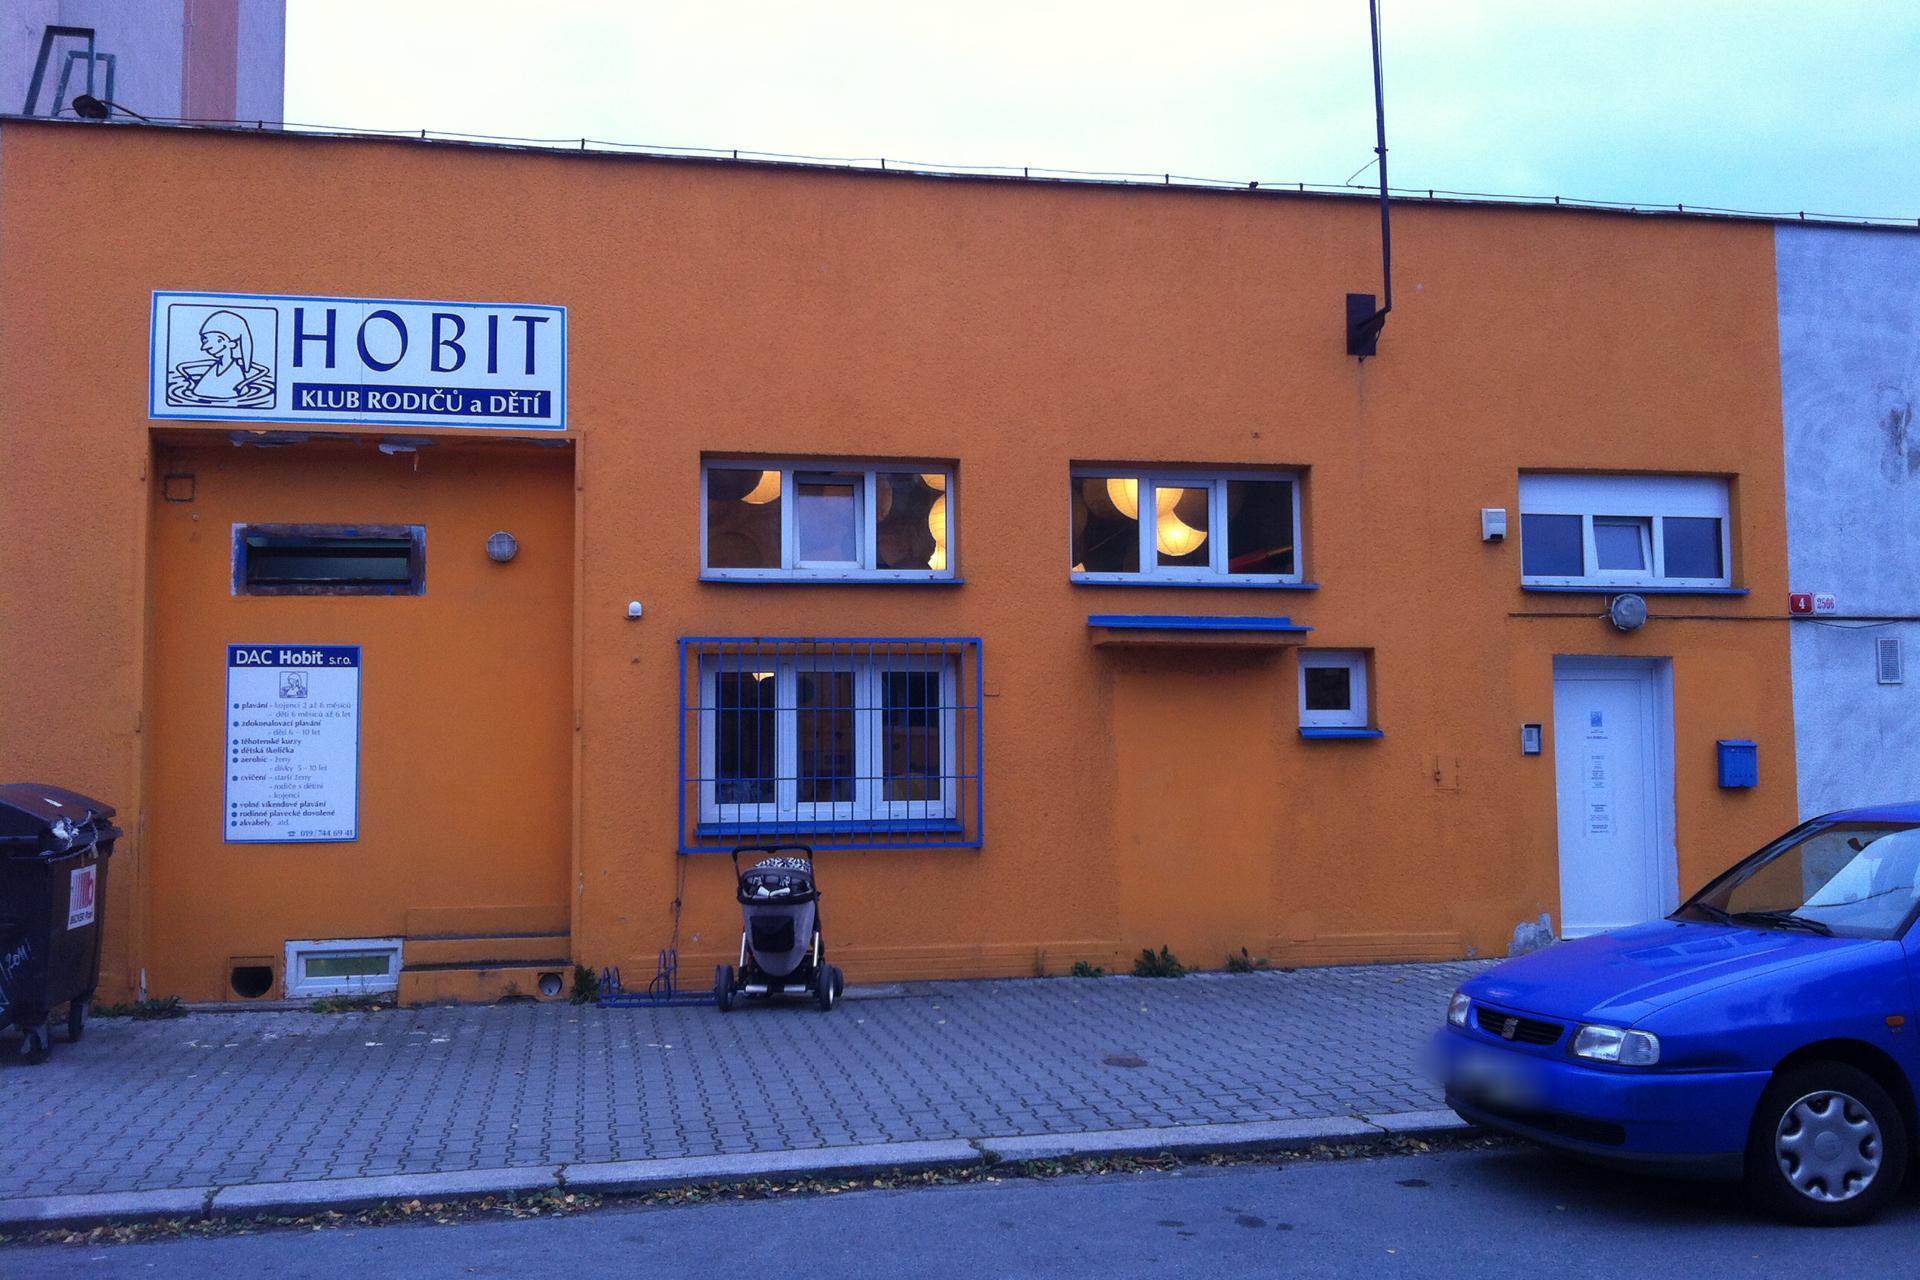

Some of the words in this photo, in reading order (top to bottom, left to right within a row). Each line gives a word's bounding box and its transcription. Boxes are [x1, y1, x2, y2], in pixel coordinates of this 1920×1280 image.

[293, 307, 550, 375] HOBIT
[301, 390, 360, 409] KLUB
[368, 389, 462, 412] RODIČŮ
[470, 400, 482, 413] a
[490, 391, 541, 415] DĚTÍ
[1799, 598, 1806, 609] 4
[236, 650, 272, 664] DAC
[280, 650, 323, 664] Hobit
[241, 702, 268, 710] plavání
[295, 720, 321, 728] plavání
[299, 801, 326, 809] plavání
